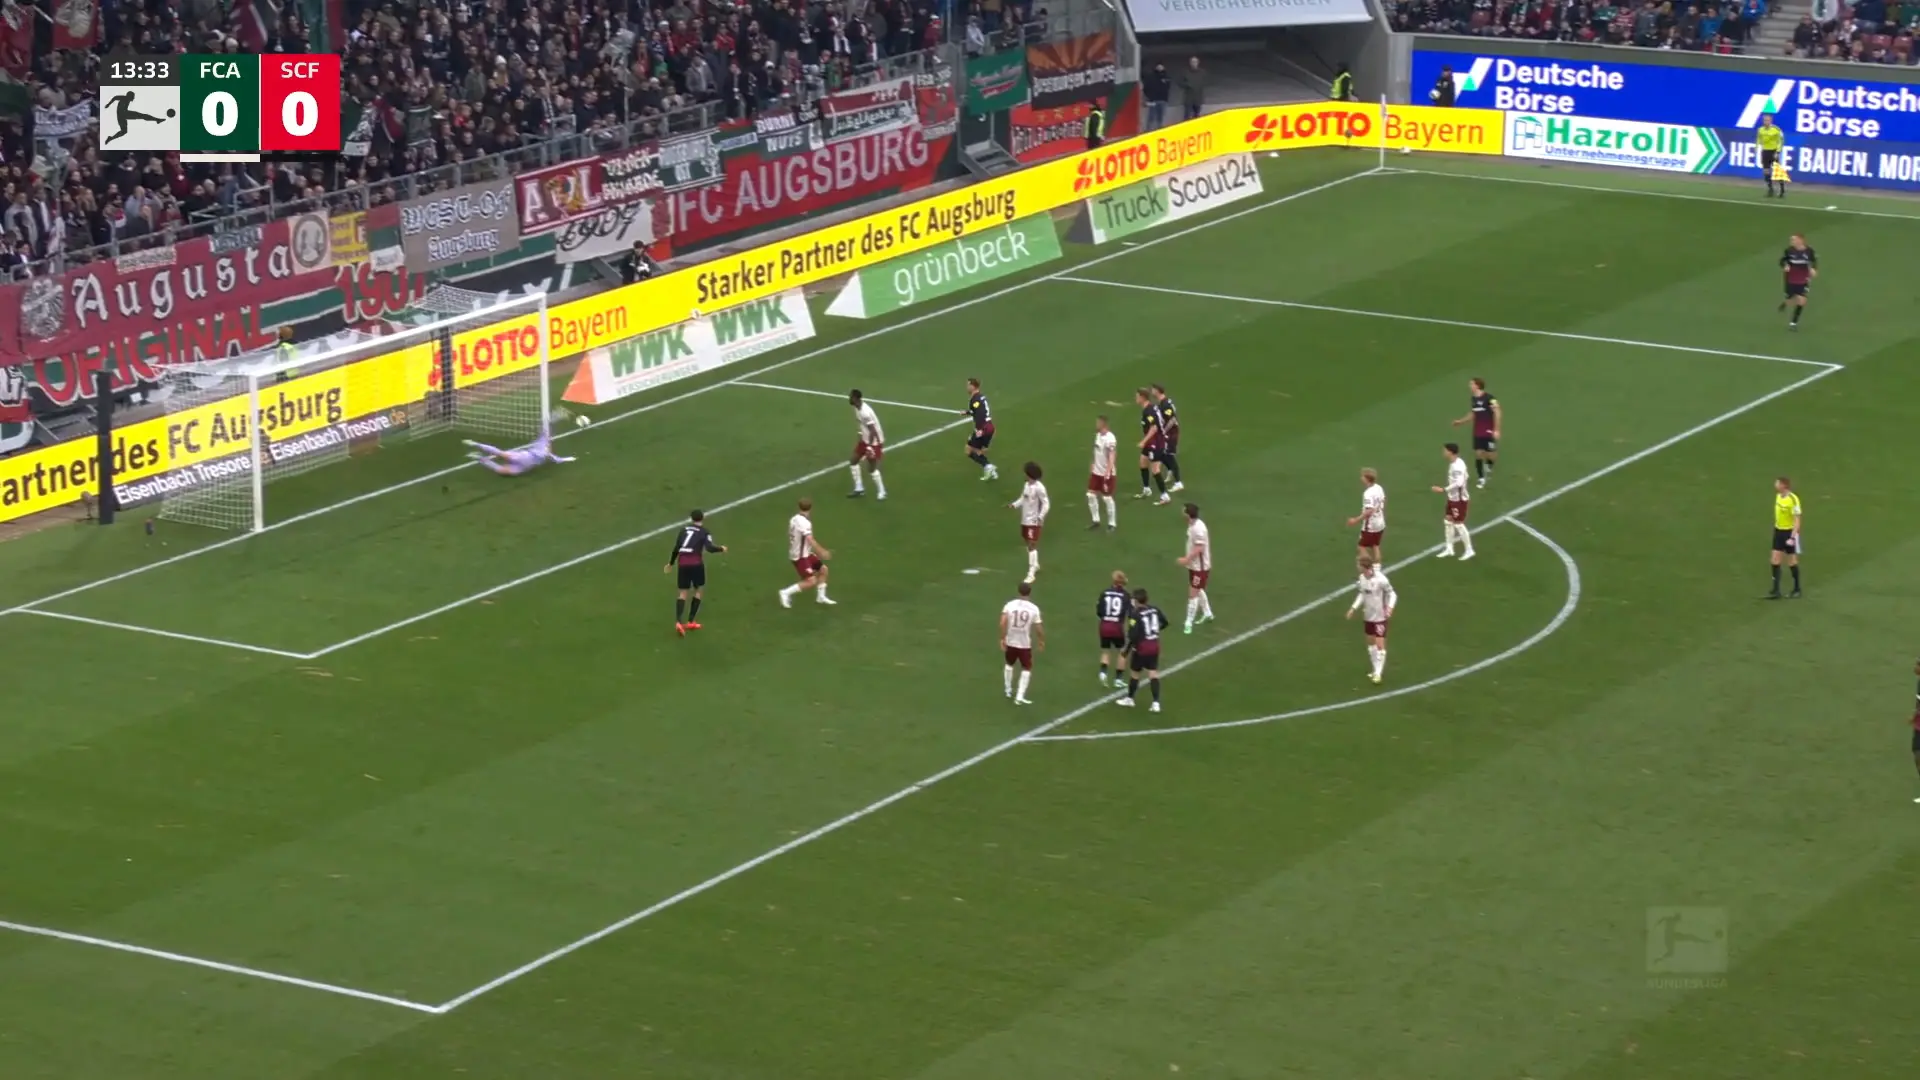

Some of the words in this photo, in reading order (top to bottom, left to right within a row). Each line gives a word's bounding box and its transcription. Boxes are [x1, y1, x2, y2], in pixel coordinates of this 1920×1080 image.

[1496, 58, 1625, 90] Deutsche
[1495, 86, 1574, 113] Börse
[1797, 80, 1920, 113] Deutsch
[1281, 111, 1371, 140] LOTTO
[1384, 115, 1484, 147] Bayern
[1546, 117, 1689, 155] Hazrolli
[1796, 108, 1880, 138] Börse
[734, 126, 929, 218] AUGSBURG
[1095, 143, 1151, 184] LOTTO
[1157, 131, 1213, 167] Bayern
[1545, 145, 1687, 168] Unternehmensgruppe
[1731, 141, 1794, 171] HEUE
[1799, 147, 1873, 177] BAUEN.
[1099, 190, 1164, 228] Truck
[1168, 156, 1256, 207] Scout24
[697, 261, 775, 304] Starker
[781, 238, 856, 279] Partner
[862, 224, 894, 255] des
[900, 211, 921, 243] FC
[927, 188, 1016, 236] Augsburg
[894, 223, 1030, 306] grünbeck
[71, 242, 290, 328] Augusta
[711, 292, 793, 346] WWK
[459, 325, 540, 377] LOTTO
[551, 305, 628, 349] Bayern
[608, 322, 693, 378] WWK
[111, 437, 160, 476] des
[168, 419, 201, 459] FC
[269, 425, 342, 461] Eisenbach
[112, 468, 196, 505] Eisenbach
[1012, 610, 1029, 629] 19
[1105, 596, 1122, 616] 19
[1142, 613, 1160, 635] 14
